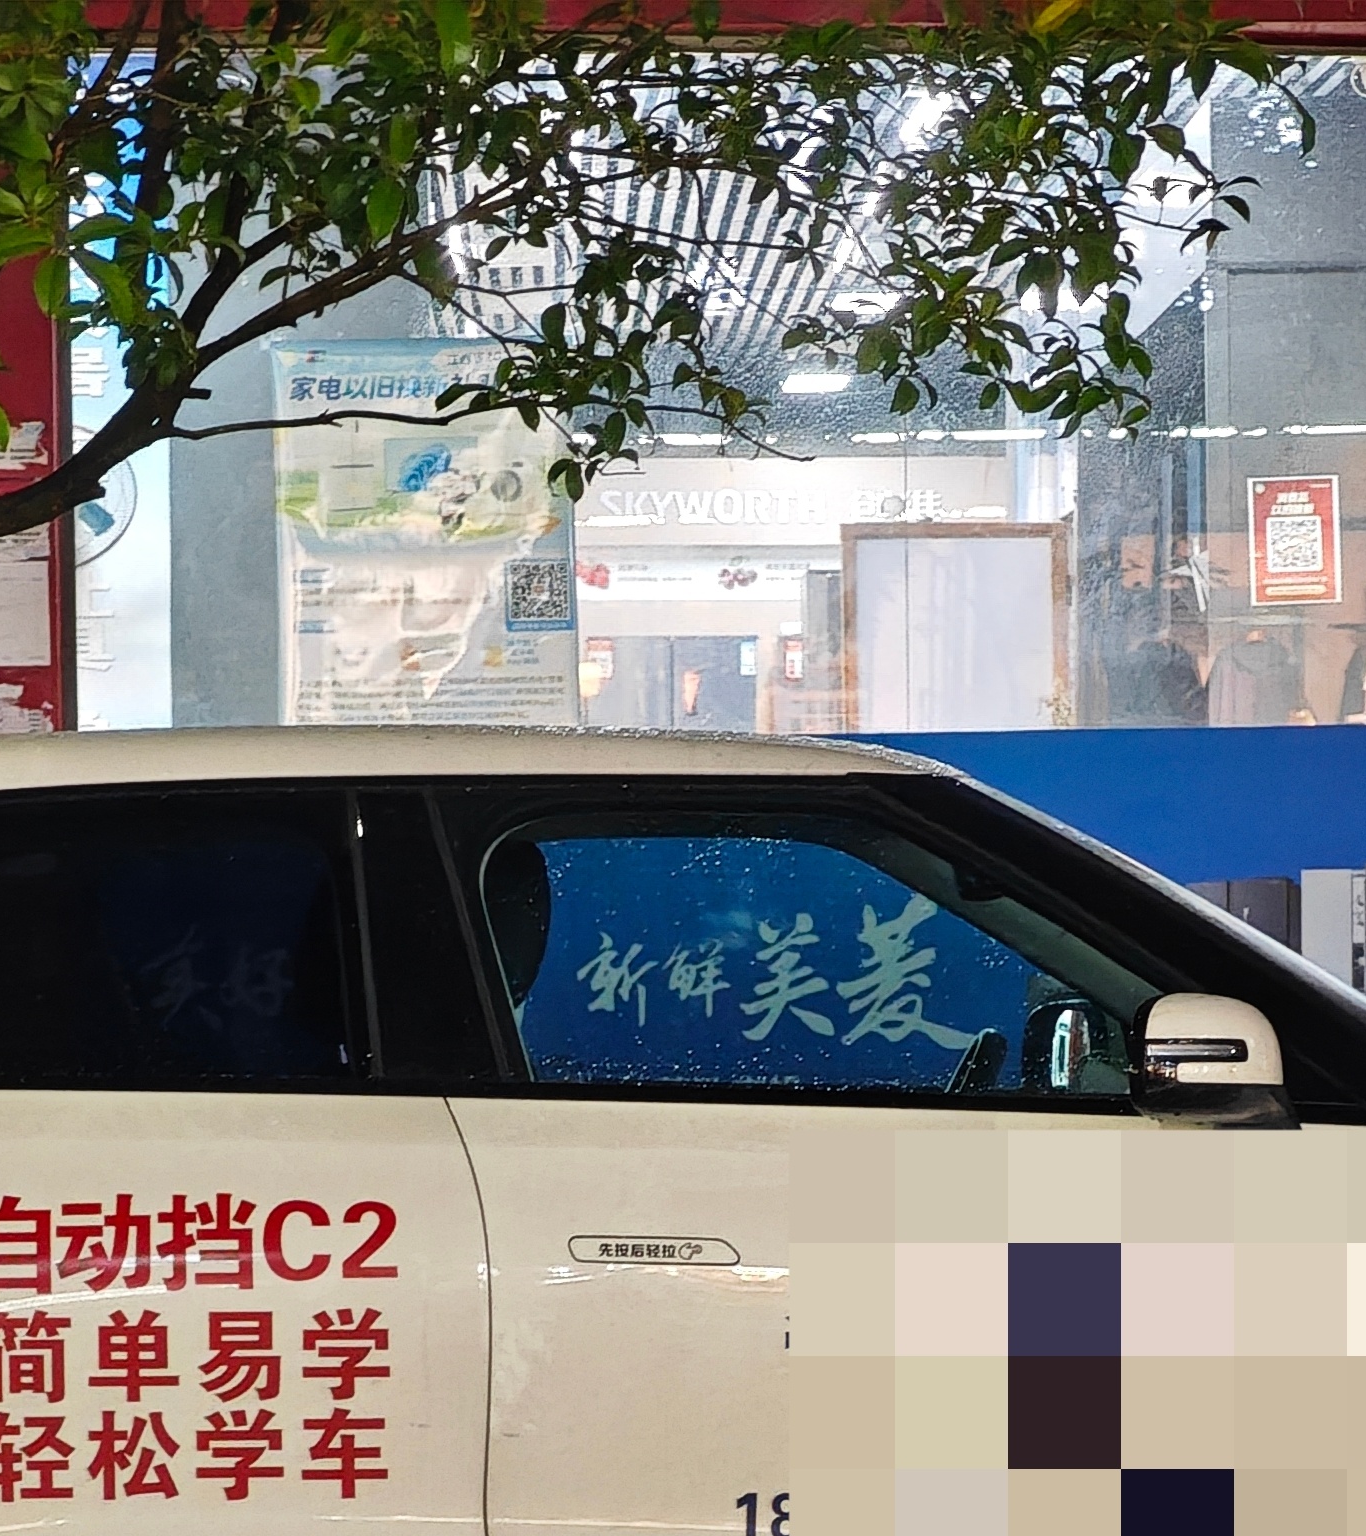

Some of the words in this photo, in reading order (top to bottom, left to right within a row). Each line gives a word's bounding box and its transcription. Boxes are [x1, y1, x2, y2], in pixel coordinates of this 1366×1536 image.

[599, 488, 829, 525] SKYWORTH
[598, 1243, 677, 1260] 先按后轻拉
